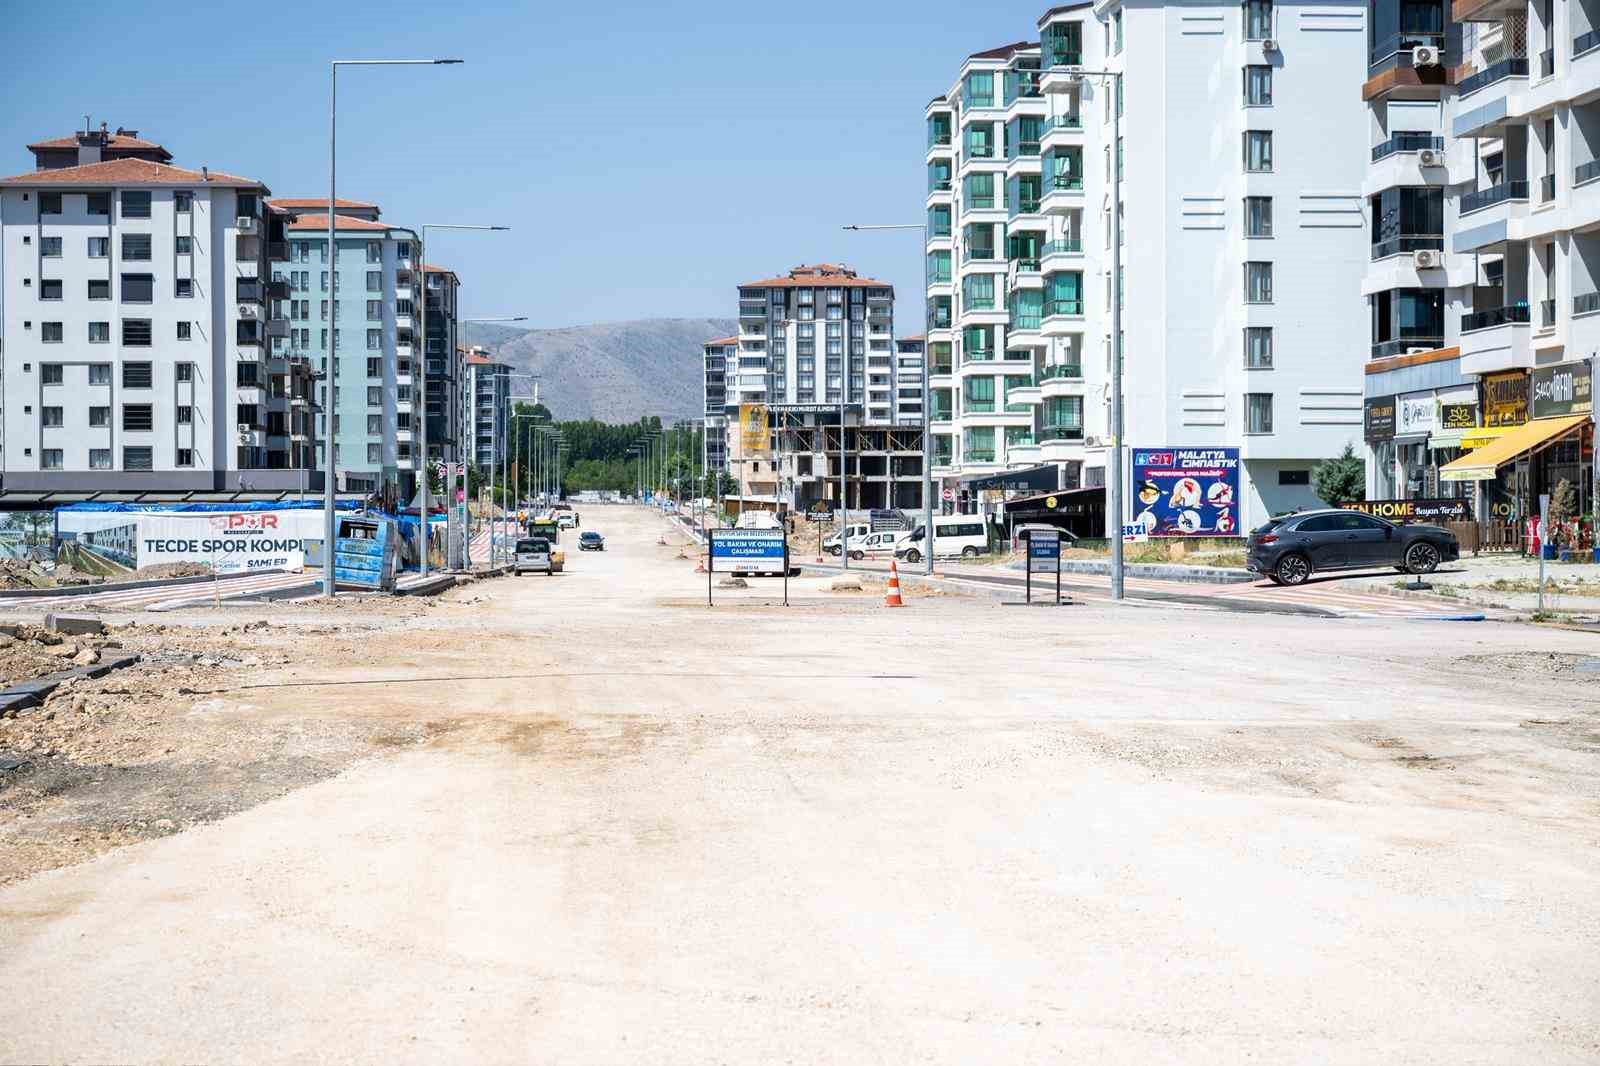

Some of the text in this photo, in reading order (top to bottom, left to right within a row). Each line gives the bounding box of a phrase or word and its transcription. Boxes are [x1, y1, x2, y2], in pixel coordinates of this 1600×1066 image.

[1178, 450, 1226, 460] MALATYA
[1373, 503, 1414, 516] HOME
[145, 539, 198, 553] TECDE
[201, 539, 247, 553] SPOR
